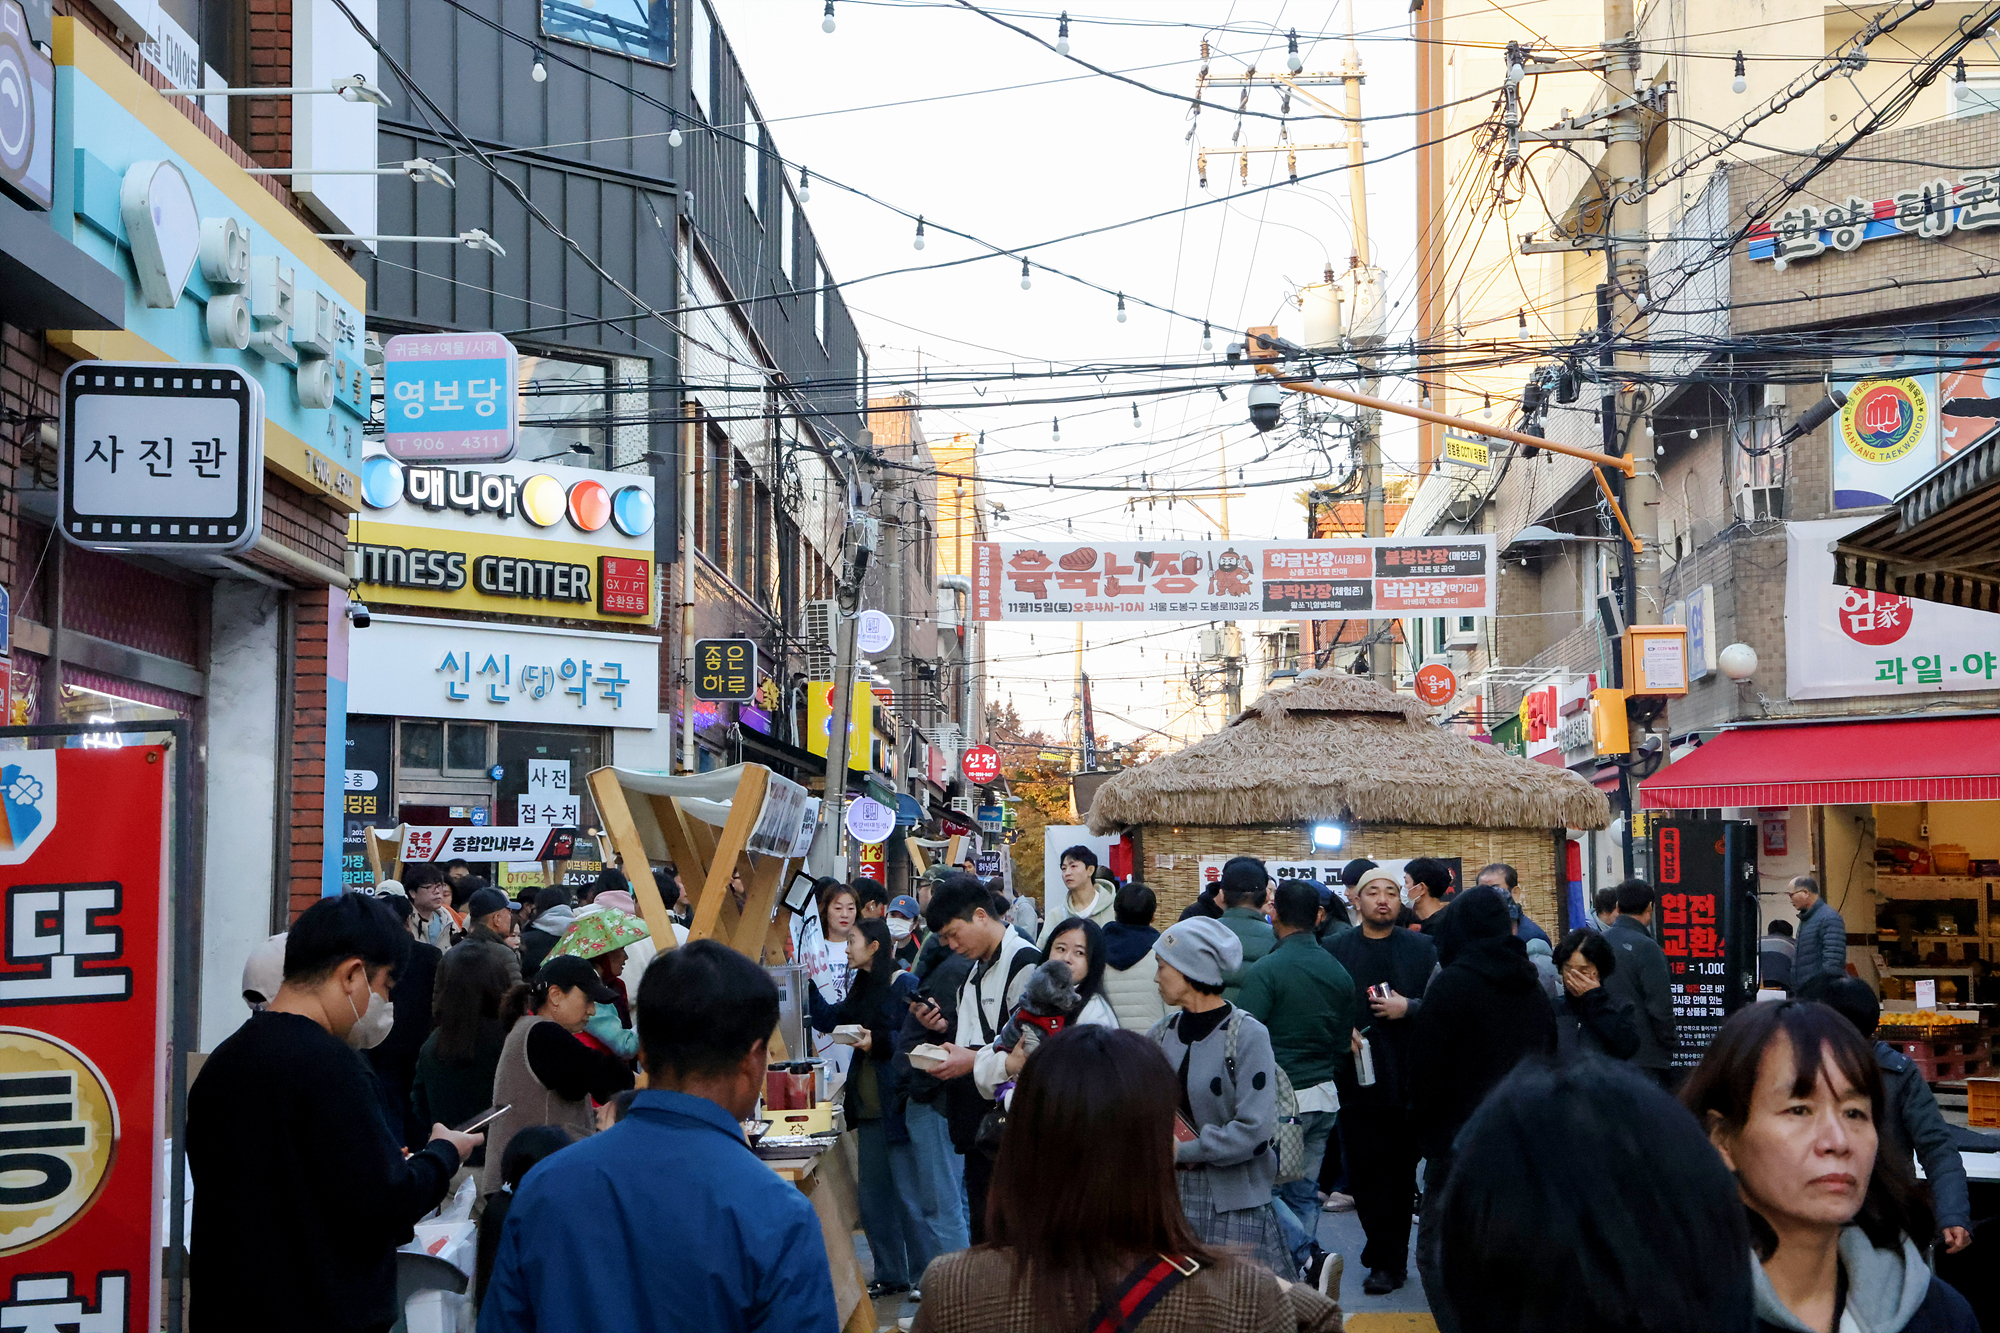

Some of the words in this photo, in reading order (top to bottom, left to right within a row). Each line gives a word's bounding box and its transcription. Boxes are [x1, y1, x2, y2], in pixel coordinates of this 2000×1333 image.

[1771, 196, 1873, 262] 한양
[208, 217, 336, 409] 영보당
[394, 340, 498, 357] 귀금속/예물/시계
[393, 378, 502, 419] 영보당
[396, 439, 407, 451] T
[413, 438, 445, 450] 906
[460, 436, 499, 449] 4311
[1844, 423, 1877, 460] HANYANG
[1879, 414, 1925, 461] TAEKWONDO
[84, 435, 228, 479] 사진관
[407, 467, 517, 516] 매니아
[477, 555, 591, 601] CENTER
[605, 578, 621, 590] GX
[632, 581, 646, 592] PT
[605, 594, 646, 610] 순환운동
[1149, 602, 1167, 612] 서울
[1169, 602, 1198, 612] 도봉구
[1248, 601, 1260, 611] 25
[704, 646, 744, 671] 좋은
[703, 674, 746, 694] 하루
[965, 753, 997, 769] 신점
[531, 768, 568, 790] 사전
[473, 812, 485, 821] ADT
[521, 803, 578, 825] 접수처
[452, 836, 535, 853] 종합안내부스
[1661, 892, 1717, 925] 엽전
